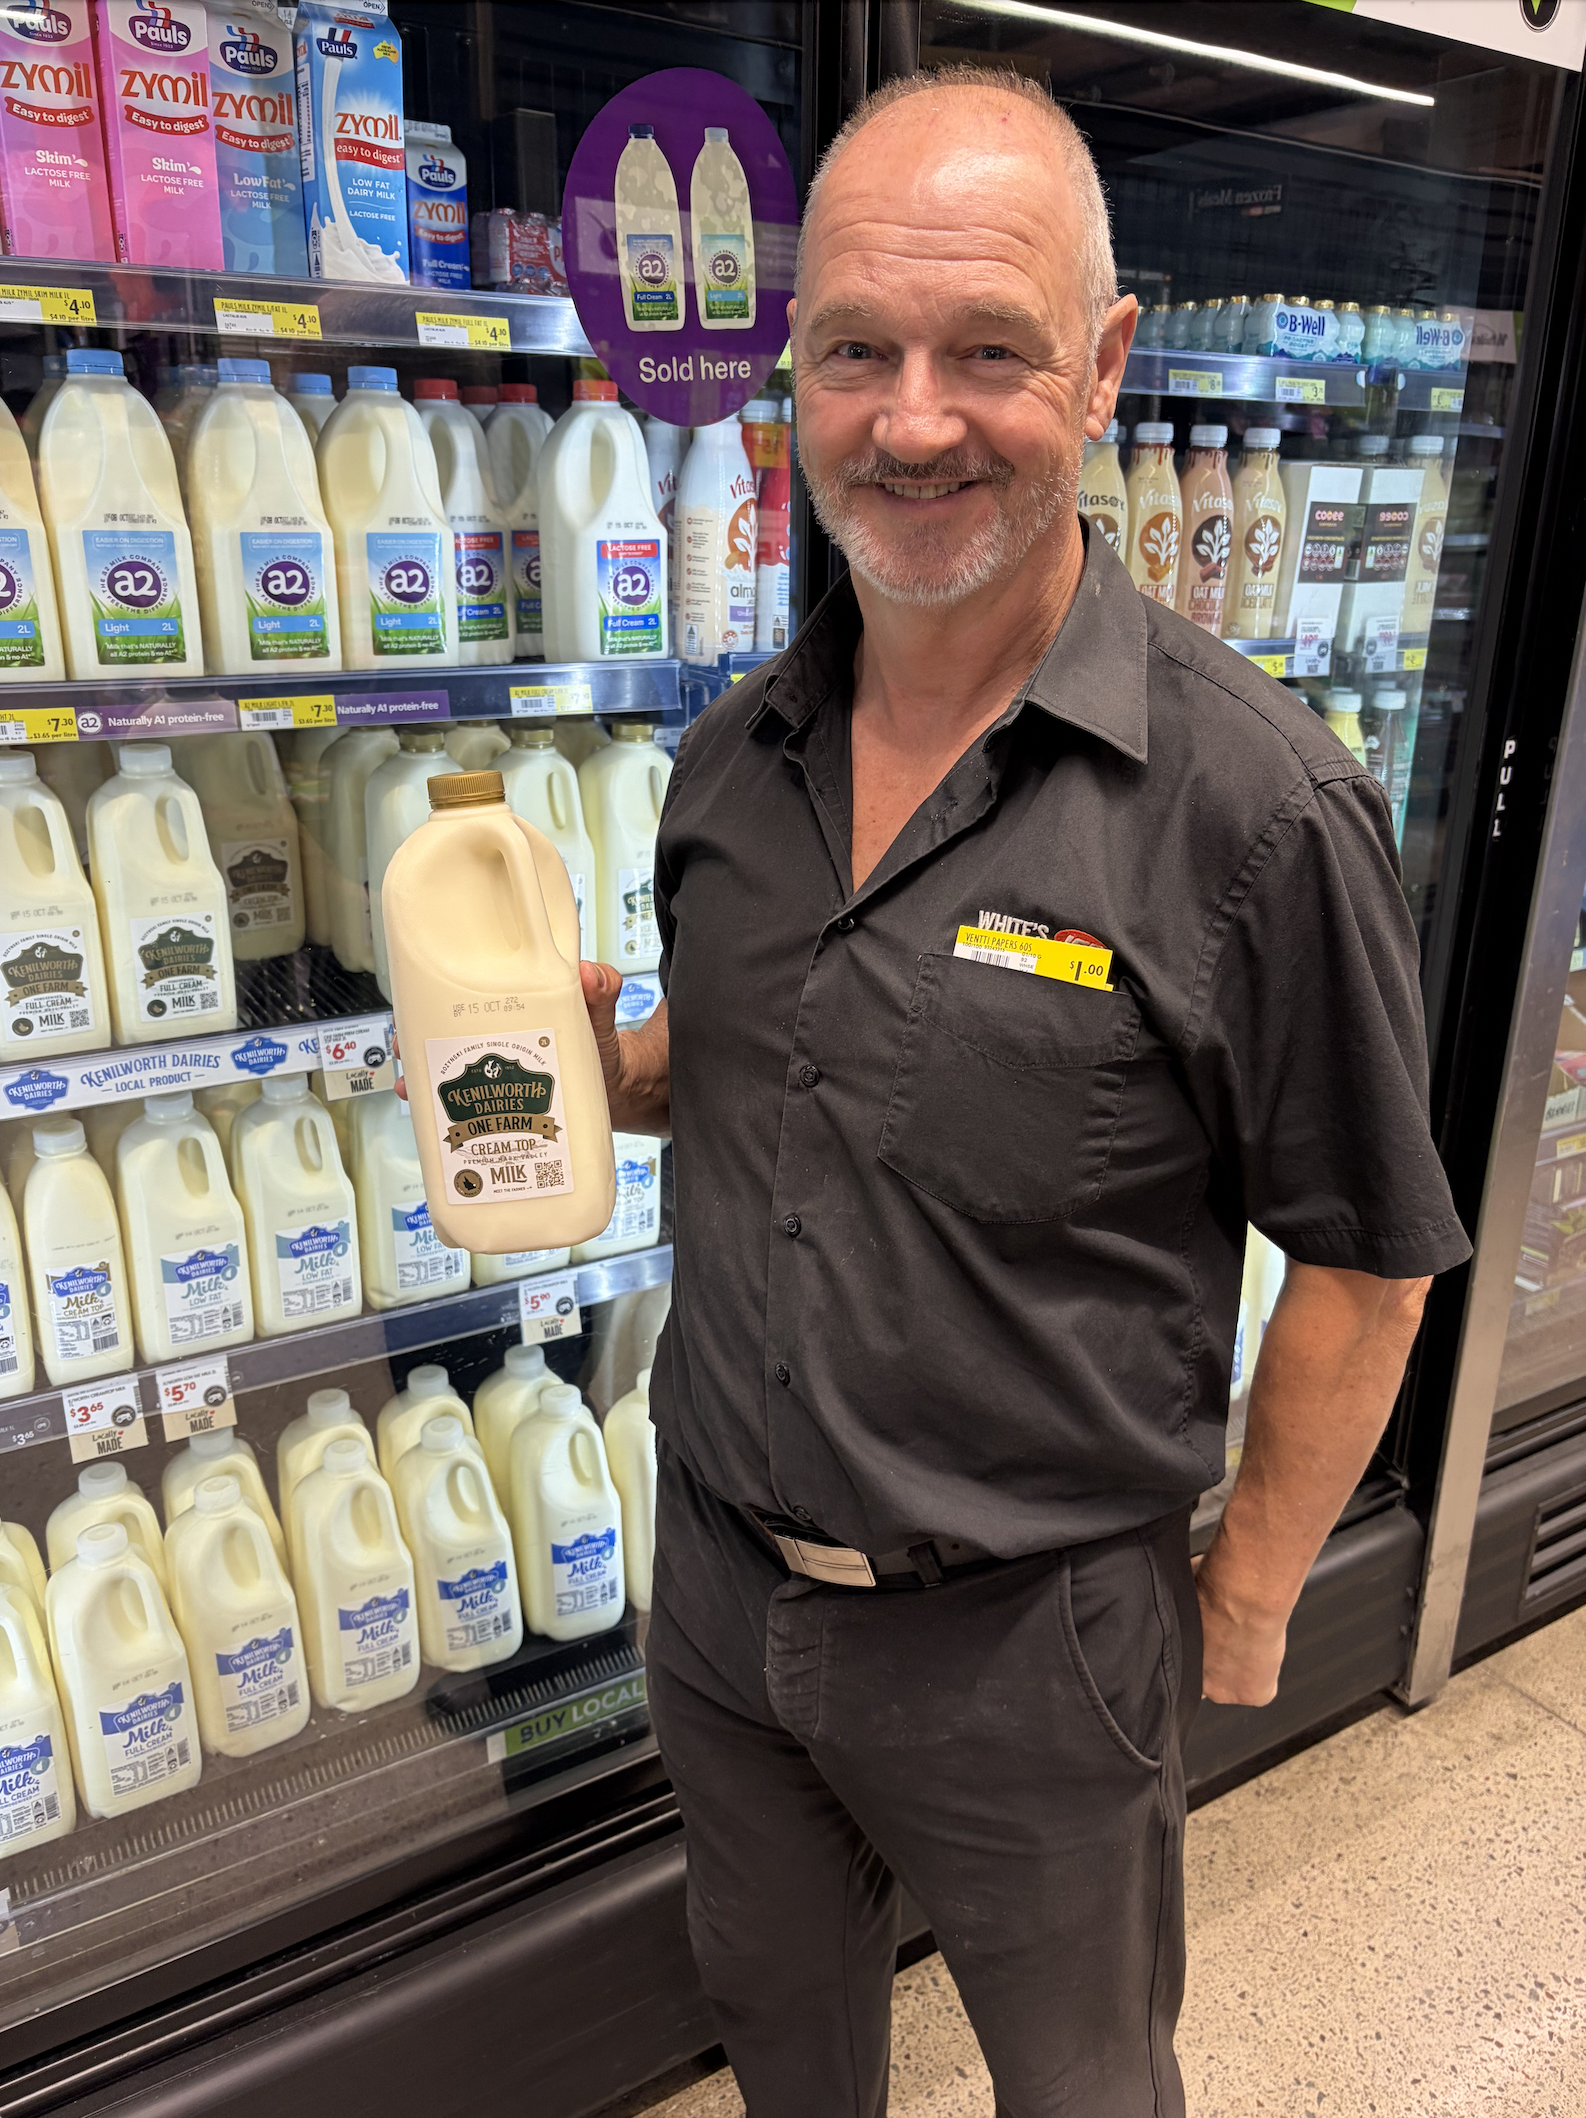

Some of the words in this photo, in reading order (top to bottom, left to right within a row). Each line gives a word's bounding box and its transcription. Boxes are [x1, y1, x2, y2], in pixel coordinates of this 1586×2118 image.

[135, 20, 188, 45] Pauls
[322, 41, 354, 56] Pauls
[225, 46, 275, 69] Pauls
[12, 104, 40, 122] Easy
[42, 111, 55, 123] to
[131, 111, 157, 131] Easy
[160, 120, 172, 131] to
[222, 132, 247, 149] Easy
[248, 139, 259, 148] to
[36, 150, 72, 165] Skim
[337, 144, 358, 156] easy
[360, 148, 370, 158] to
[152, 157, 187, 173] Skim
[25, 167, 67, 179] LACTOSE
[69, 169, 91, 181] FREE
[141, 174, 181, 186] LACTOSE
[183, 177, 204, 188] FREE
[422, 168, 455, 184] Pauls
[49, 177, 71, 189] MILK
[163, 185, 185, 195] MILK
[352, 178, 373, 188] LOW
[375, 180, 390, 189] FAT
[231, 190, 269, 201] LACTOSE
[270, 193, 290, 203] FREE
[348, 188, 375, 198] DAIRY
[376, 190, 395, 200] MILK
[252, 201, 271, 210] MILK
[350, 210, 379, 220] LACTOSE
[380, 213, 396, 222] FREE
[64, 299, 91, 315] $4.10
[293, 314, 317, 329] $4.10
[486, 327, 507, 342] $4.10
[639, 357, 693, 383] Sold
[700, 356, 751, 381] here
[114, 570, 157, 597] a2
[267, 570, 306, 595] a2
[390, 569, 427, 594] a2
[460, 565, 491, 587] a2
[616, 573, 648, 597] a2
[17, 624, 31, 634] 2L
[104, 624, 130, 634] Light
[161, 622, 174, 631] 2L
[258, 621, 281, 631] Light
[309, 619, 320, 627] 2L
[380, 616, 402, 627] Light
[427, 616, 438, 625] 2L
[310, 704, 333, 718] $7.30
[337, 703, 375, 717] Naturally
[377, 703, 387, 712] A1
[389, 701, 438, 713] protein-free
[47, 717, 74, 732] $7.30
[80, 715, 99, 728] a2
[108, 715, 152, 730] Naturally
[154, 715, 166, 724] A1
[167, 712, 225, 727] protein-free
[1493, 738, 1516, 838] PULL
[978, 910, 1050, 939] WHITE'S
[965, 932, 990, 946] VENTTI
[991, 937, 1017, 950] PAPERS
[1019, 942, 1033, 952] 60S
[145, 943, 210, 961] KENILWORTH
[8, 960, 78, 978] KENILWORTH
[28, 970, 64, 982] DAIRIES
[158, 968, 174, 979] ONE
[177, 965, 200, 976] FARM
[1069, 960, 1104, 982] $1.00
[22, 984, 41, 996] ONE
[43, 982, 69, 993] FARM
[25, 1001, 42, 1010] FULL
[46, 997, 72, 1008] CREAM
[172, 995, 196, 1009] MILK
[452, 1003, 466, 1012] USE
[467, 1003, 480, 1014] 15
[484, 1001, 501, 1013] OCT
[503, 1003, 525, 1012] 09:54
[505, 996, 519, 1004] 272
[39, 1012, 65, 1028] MILK
[463, 1042, 484, 1054] FAMILY
[511, 1043, 533, 1056] ORIGIN
[533, 1052, 547, 1067] MILK
[80, 1055, 167, 1088] KENILWORTH
[172, 1054, 221, 1069] DAIRIES
[346, 1070, 369, 1080] Locally
[8, 1080, 66, 1098] KENILWORTH
[115, 1081, 146, 1093] LOCAL
[150, 1072, 192, 1087] PRODUCT
[351, 1077, 374, 1094] MADE
[24, 1089, 53, 1101] DAIRIES
[447, 1082, 547, 1107] KENILWORTH
[474, 1099, 524, 1115] DAIRIES
[467, 1118, 493, 1136] ONE
[495, 1116, 533, 1131] FARM
[471, 1141, 512, 1156] CREAM
[515, 1138, 536, 1151] TOP
[490, 1164, 528, 1185] MILK
[294, 1253, 337, 1275] Milk
[181, 1276, 224, 1299] Milk
[62, 1294, 99, 1310] Milk
[543, 1325, 563, 1339] MADE
[185, 1410, 209, 1421] Locally
[190, 1416, 215, 1433] MADE
[92, 1430, 118, 1442] Locally
[97, 1437, 123, 1455] MADE
[356, 1620, 396, 1645] Milk
[237, 1660, 279, 1689] Milk
[520, 1711, 567, 1745] BUY
[571, 1682, 643, 1722] LOCAL
[122, 1718, 169, 1749] Milk
[125, 1743, 145, 1757] FULL
[147, 1732, 173, 1748] CREAM
[10, 1785, 40, 1801] CREAM
